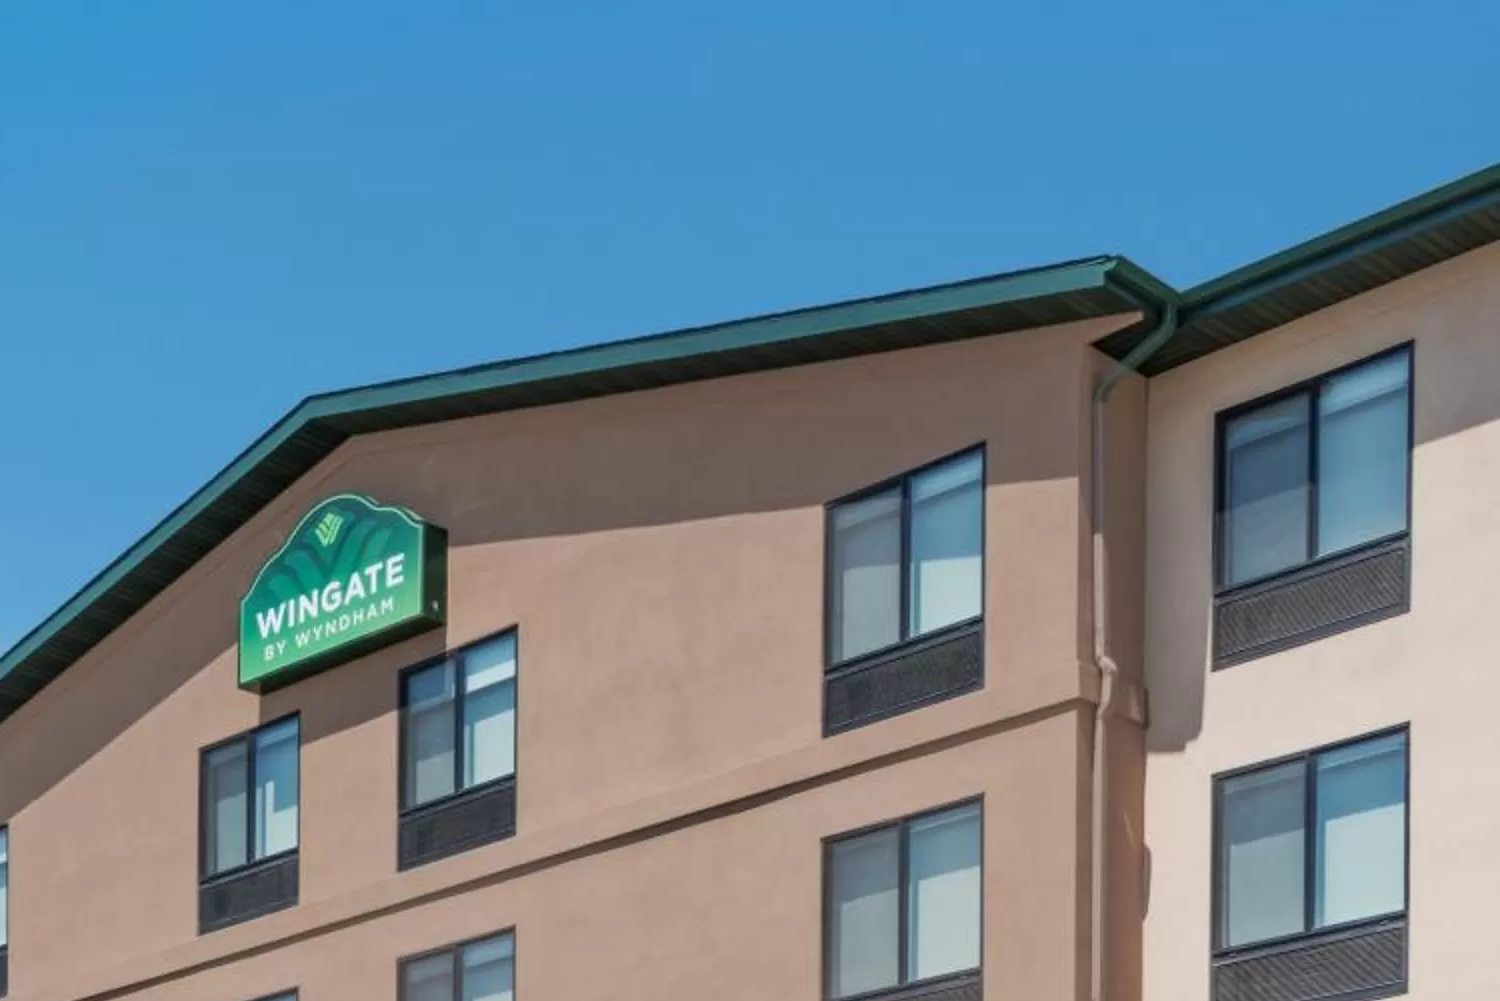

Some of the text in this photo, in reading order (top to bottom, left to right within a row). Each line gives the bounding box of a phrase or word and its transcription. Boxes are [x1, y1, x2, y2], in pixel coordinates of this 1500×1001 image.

[255, 553, 406, 640] WINGATE
[263, 596, 395, 661] BY WYNDHAM
